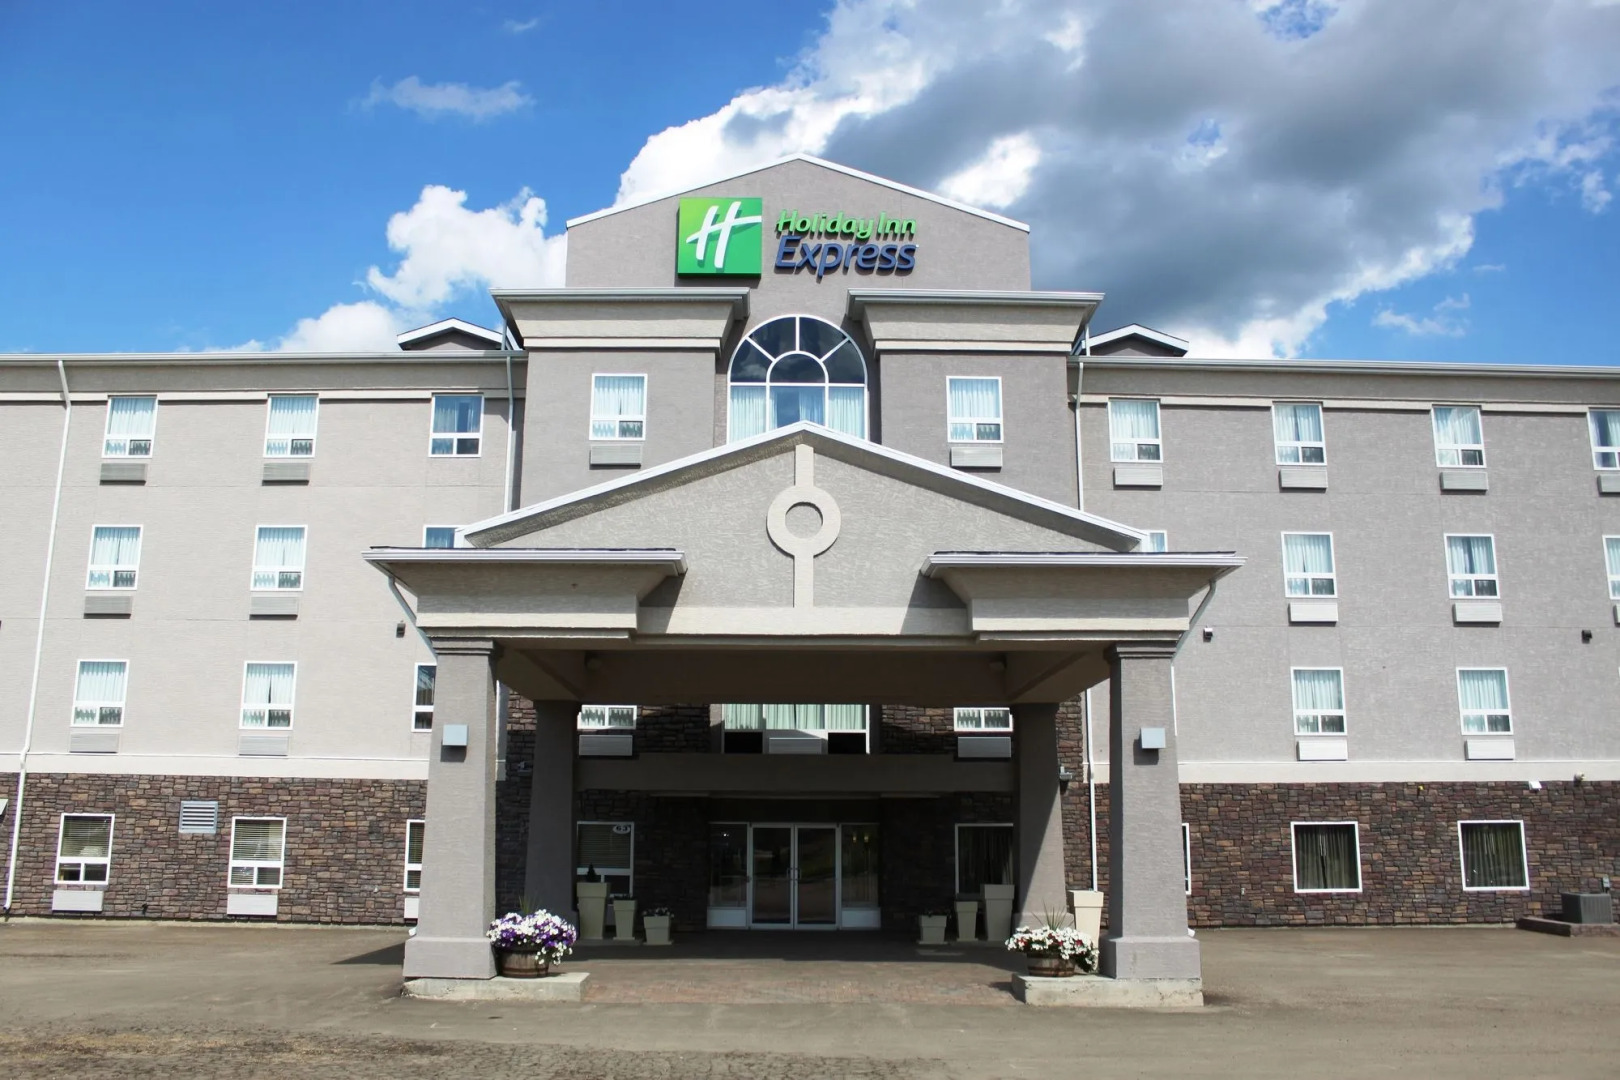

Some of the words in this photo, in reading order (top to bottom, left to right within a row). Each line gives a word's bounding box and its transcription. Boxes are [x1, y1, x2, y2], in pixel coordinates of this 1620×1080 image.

[776, 209, 874, 240] Holiday
[877, 211, 916, 235] Inn
[775, 234, 917, 277] Express
